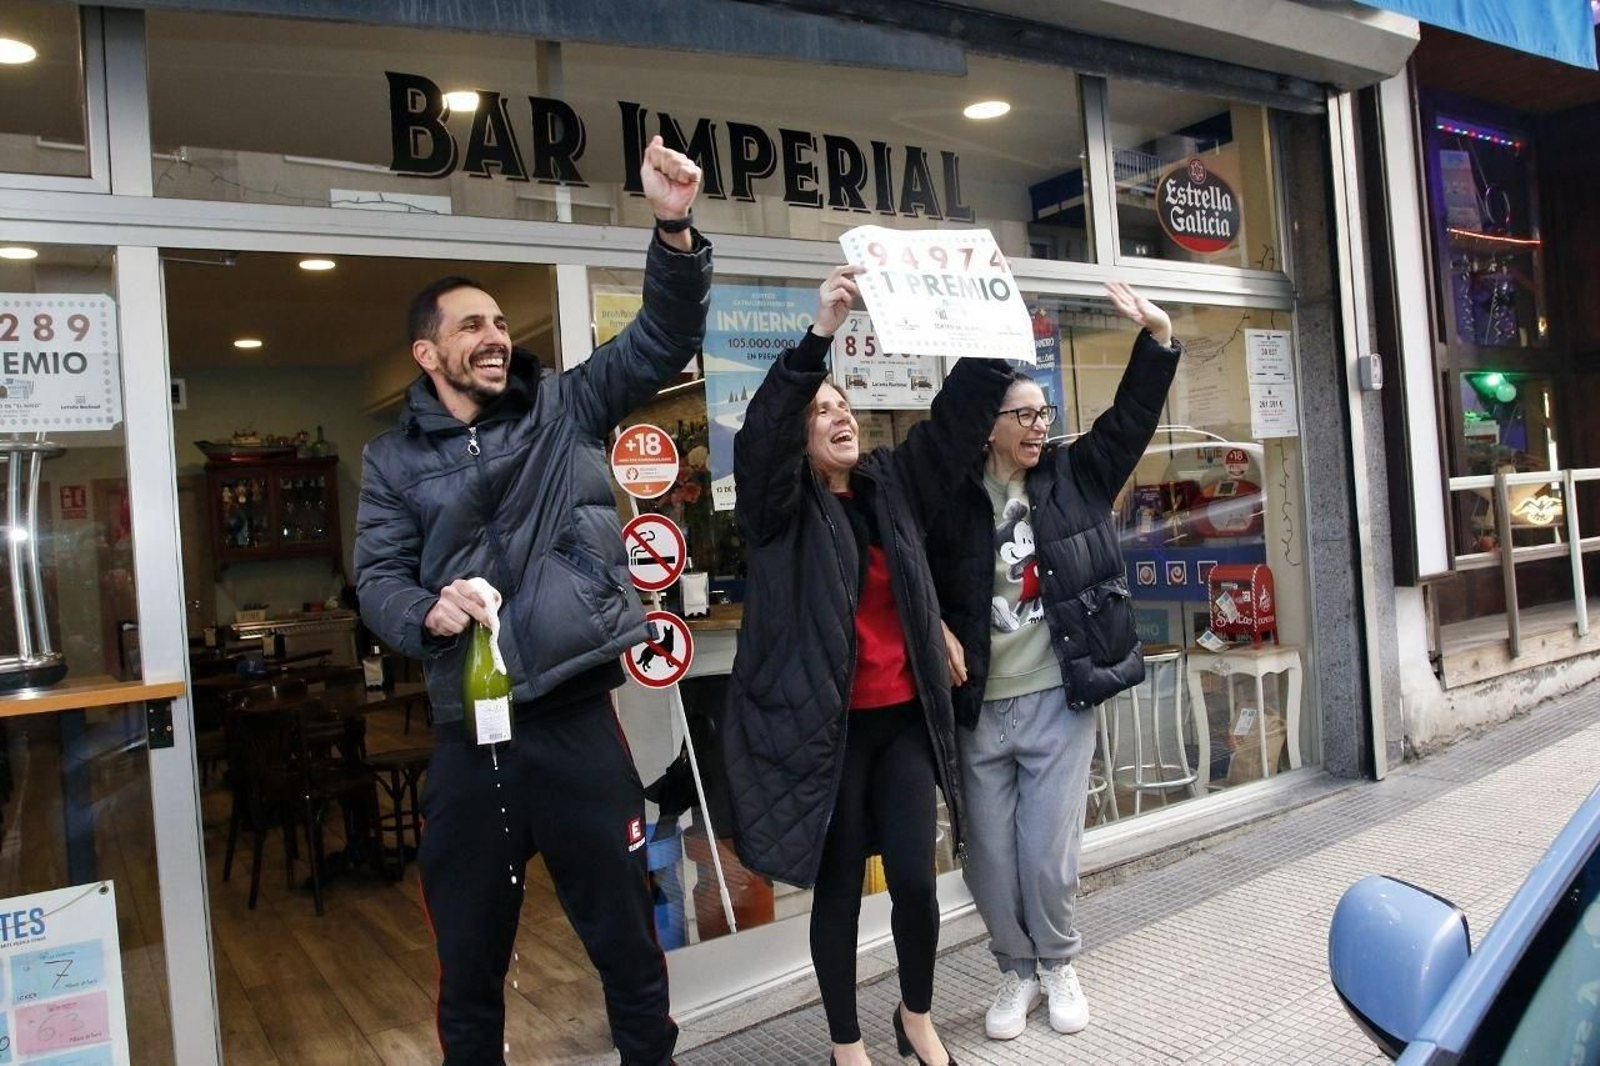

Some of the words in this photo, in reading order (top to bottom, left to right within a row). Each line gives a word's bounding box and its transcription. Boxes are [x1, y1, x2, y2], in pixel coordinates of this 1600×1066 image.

[384, 71, 589, 187] BAR
[618, 100, 976, 223] IMPERIAL
[1165, 178, 1232, 212] Estrella
[1170, 205, 1231, 237] Galicia
[880, 271, 895, 294] 1
[907, 275, 1011, 302] PREMIO
[716, 310, 812, 332] INVIERNO
[728, 338, 796, 349] 105.000.000
[758, 352, 779, 361] PREM
[3, 352, 88, 375] EMIO
[625, 432, 662, 456] +18
[631, 820, 641, 839] E
[0, 907, 46, 942] TES
[44, 959, 74, 989] 7
